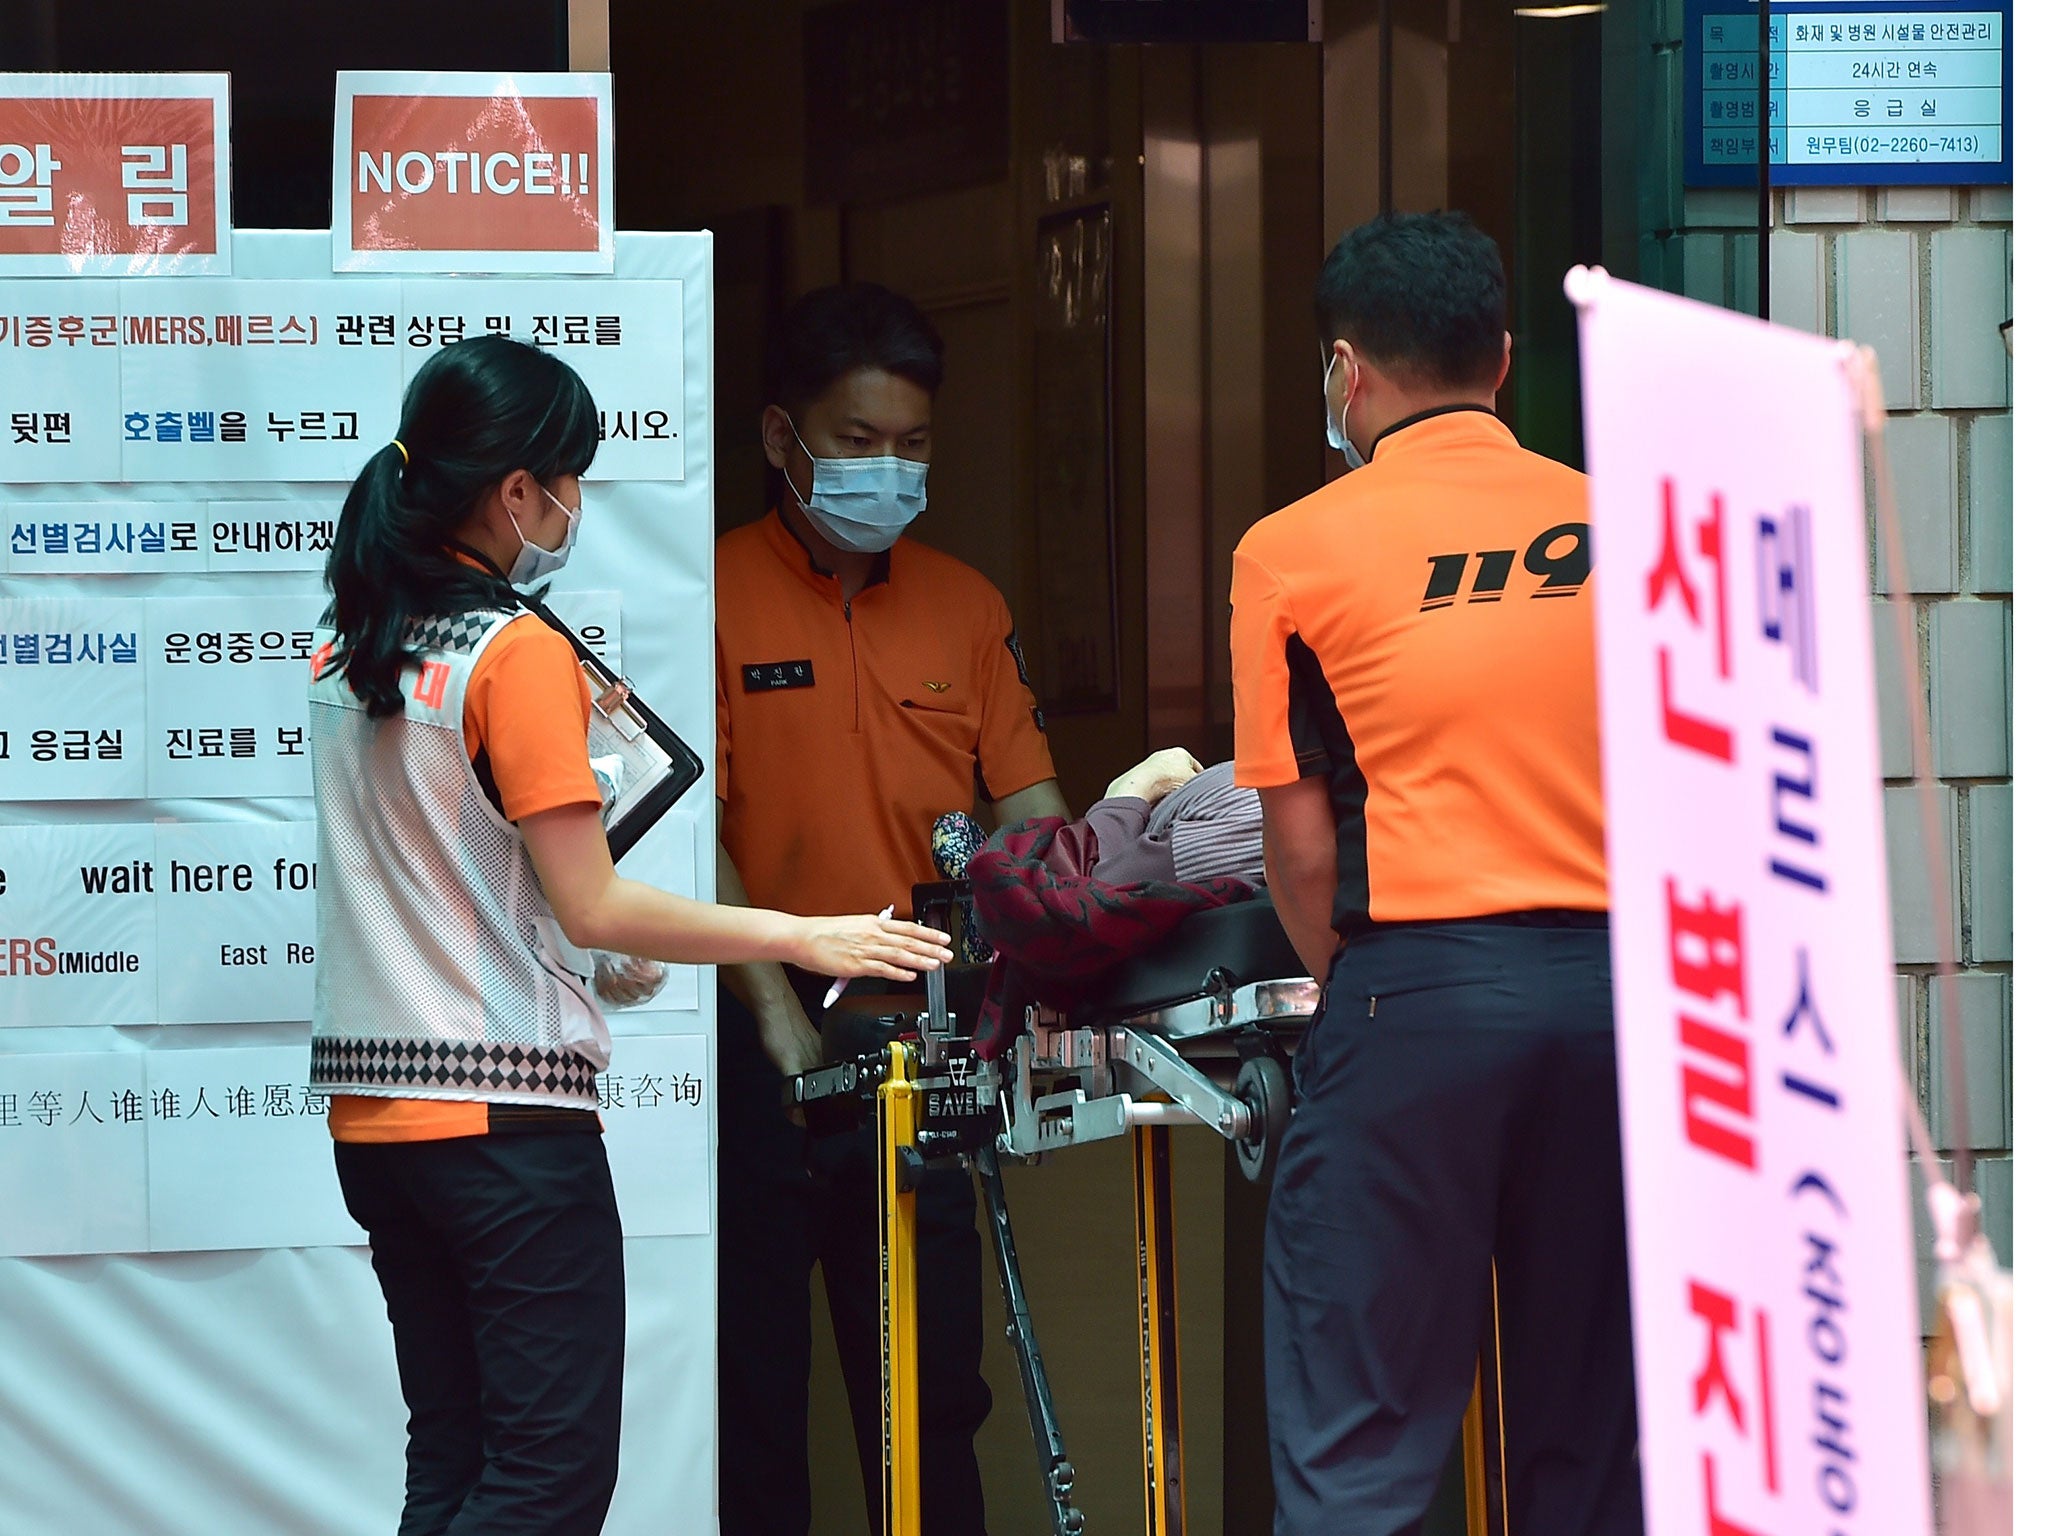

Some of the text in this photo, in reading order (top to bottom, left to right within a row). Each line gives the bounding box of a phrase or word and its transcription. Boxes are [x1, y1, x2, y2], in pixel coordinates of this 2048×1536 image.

[1795, 23, 1991, 42] 화재 및 병원 시설물 안전관리
[1852, 61, 1937, 79] 24시간 연속
[1806, 135, 1979, 155] 원무팀(02-2260-7413)
[358, 151, 589, 195] NOTICE!!
[335, 315, 396, 346] 관련
[407, 315, 466, 347] 상담
[531, 316, 622, 346] 진료를
[11, 412, 71, 444] 뒷편
[124, 411, 248, 443] 호출벨을
[267, 411, 359, 442] 누르고
[10, 522, 198, 554] 선별검사실로
[1420, 522, 1597, 613] 119
[164, 631, 314, 665] 운영중으로
[30, 729, 124, 761] 응급실
[166, 727, 257, 759] 진료를
[277, 726, 311, 756] 보
[81, 860, 154, 894] wait
[171, 859, 253, 893] here
[220, 944, 268, 966] East
[287, 943, 315, 965] Re
[1756, 504, 1857, 1536] 메르스(중동
